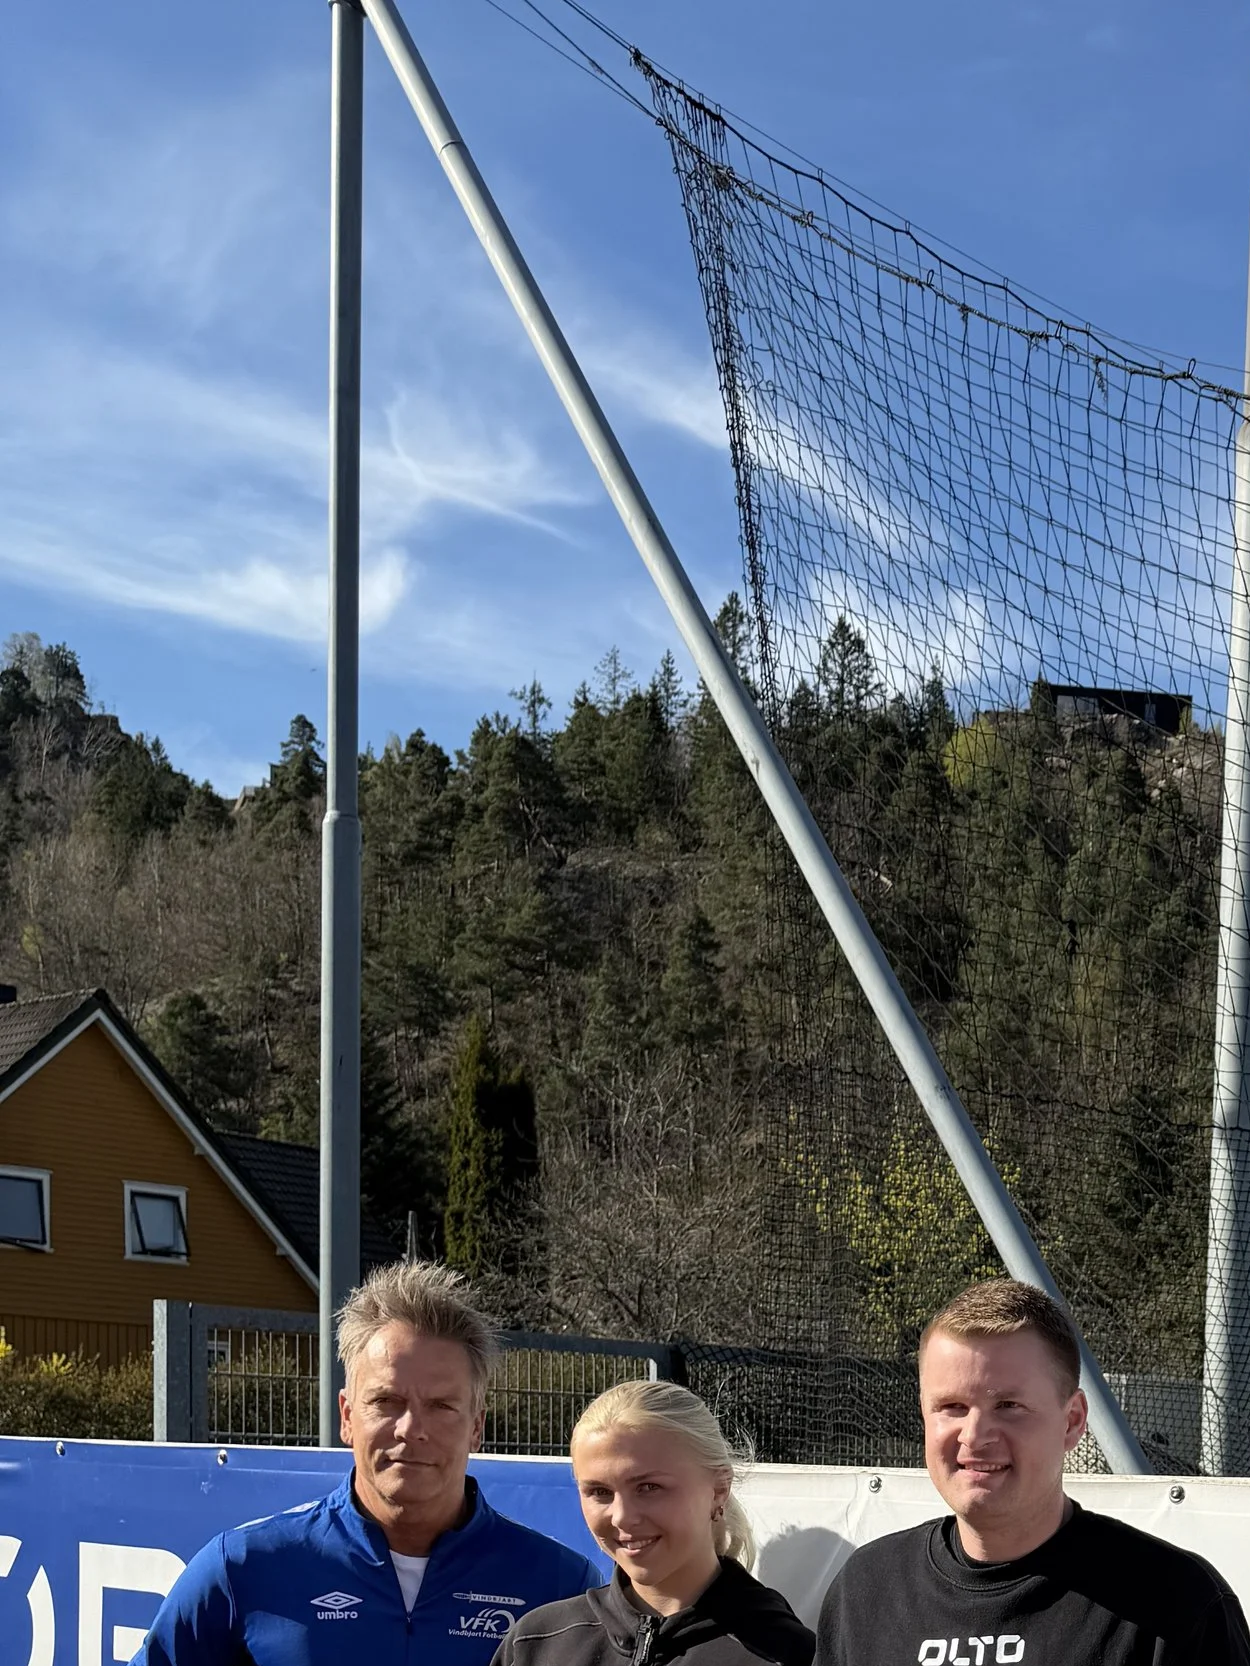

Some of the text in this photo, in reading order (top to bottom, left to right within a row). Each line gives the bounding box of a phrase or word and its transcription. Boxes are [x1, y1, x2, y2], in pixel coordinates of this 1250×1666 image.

[317, 1610, 358, 1620] umbro
[460, 1616, 501, 1632] VFK
[918, 1634, 1025, 1666] OLTO
